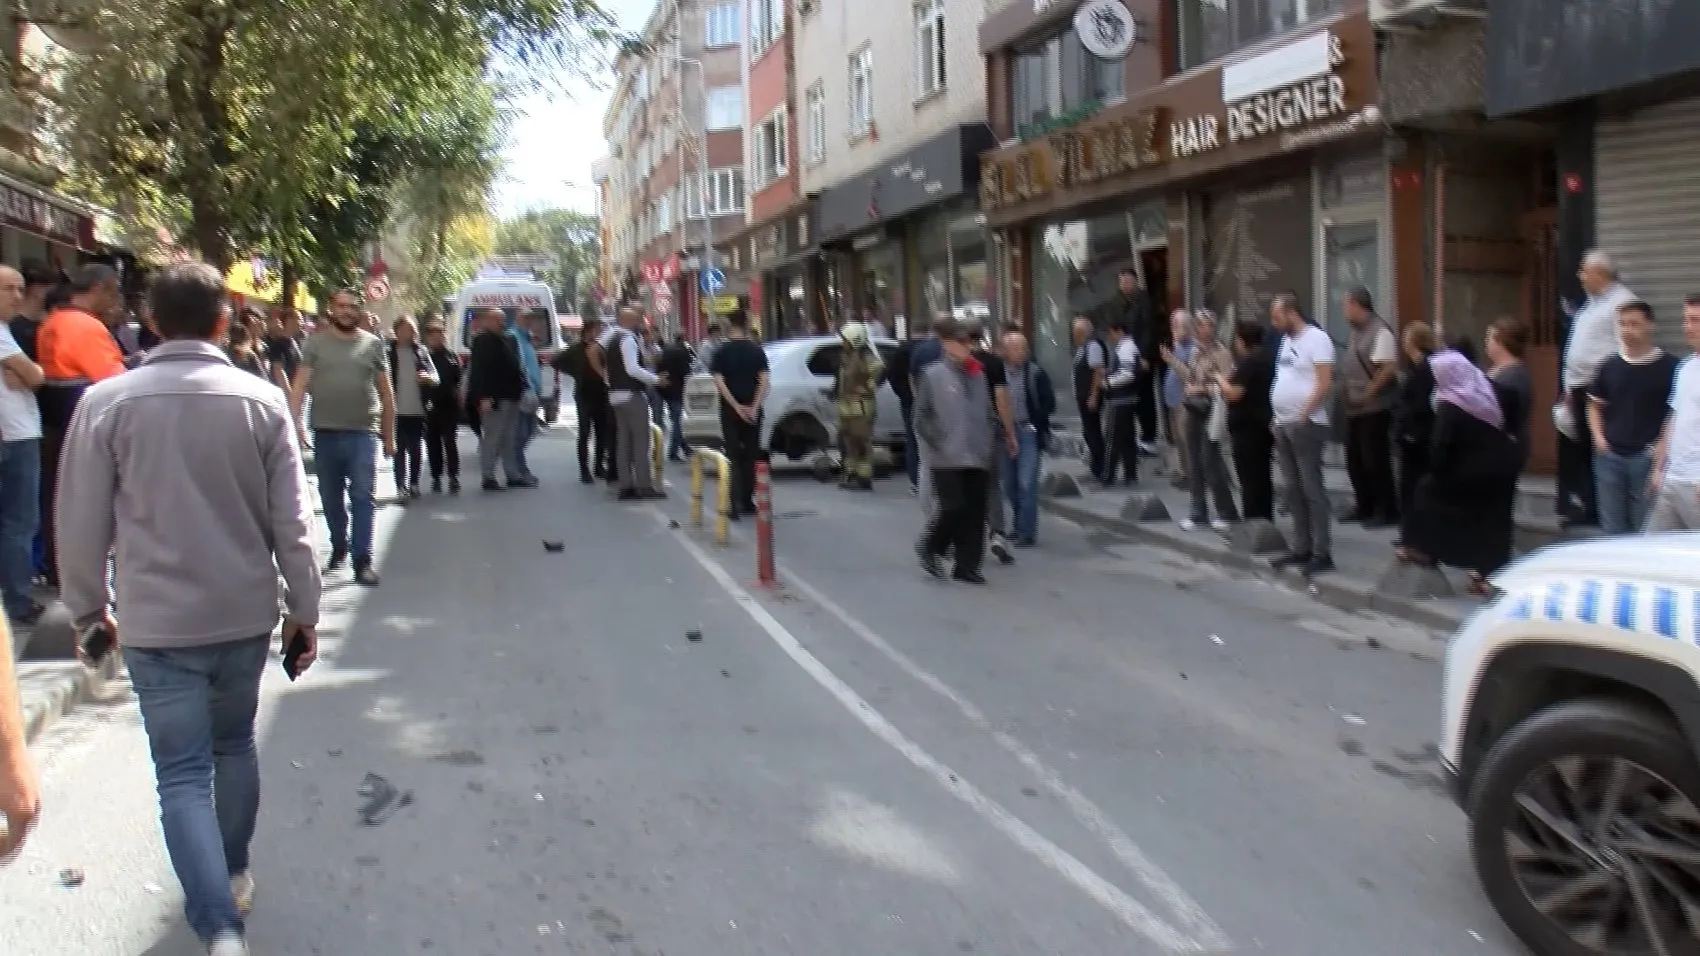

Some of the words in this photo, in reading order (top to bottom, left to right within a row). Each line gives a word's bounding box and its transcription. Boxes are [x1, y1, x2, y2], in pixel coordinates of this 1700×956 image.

[1170, 114, 1220, 158] HAIR
[1227, 74, 1347, 143] DESIGNER
[471, 293, 542, 306] AMBULANS
